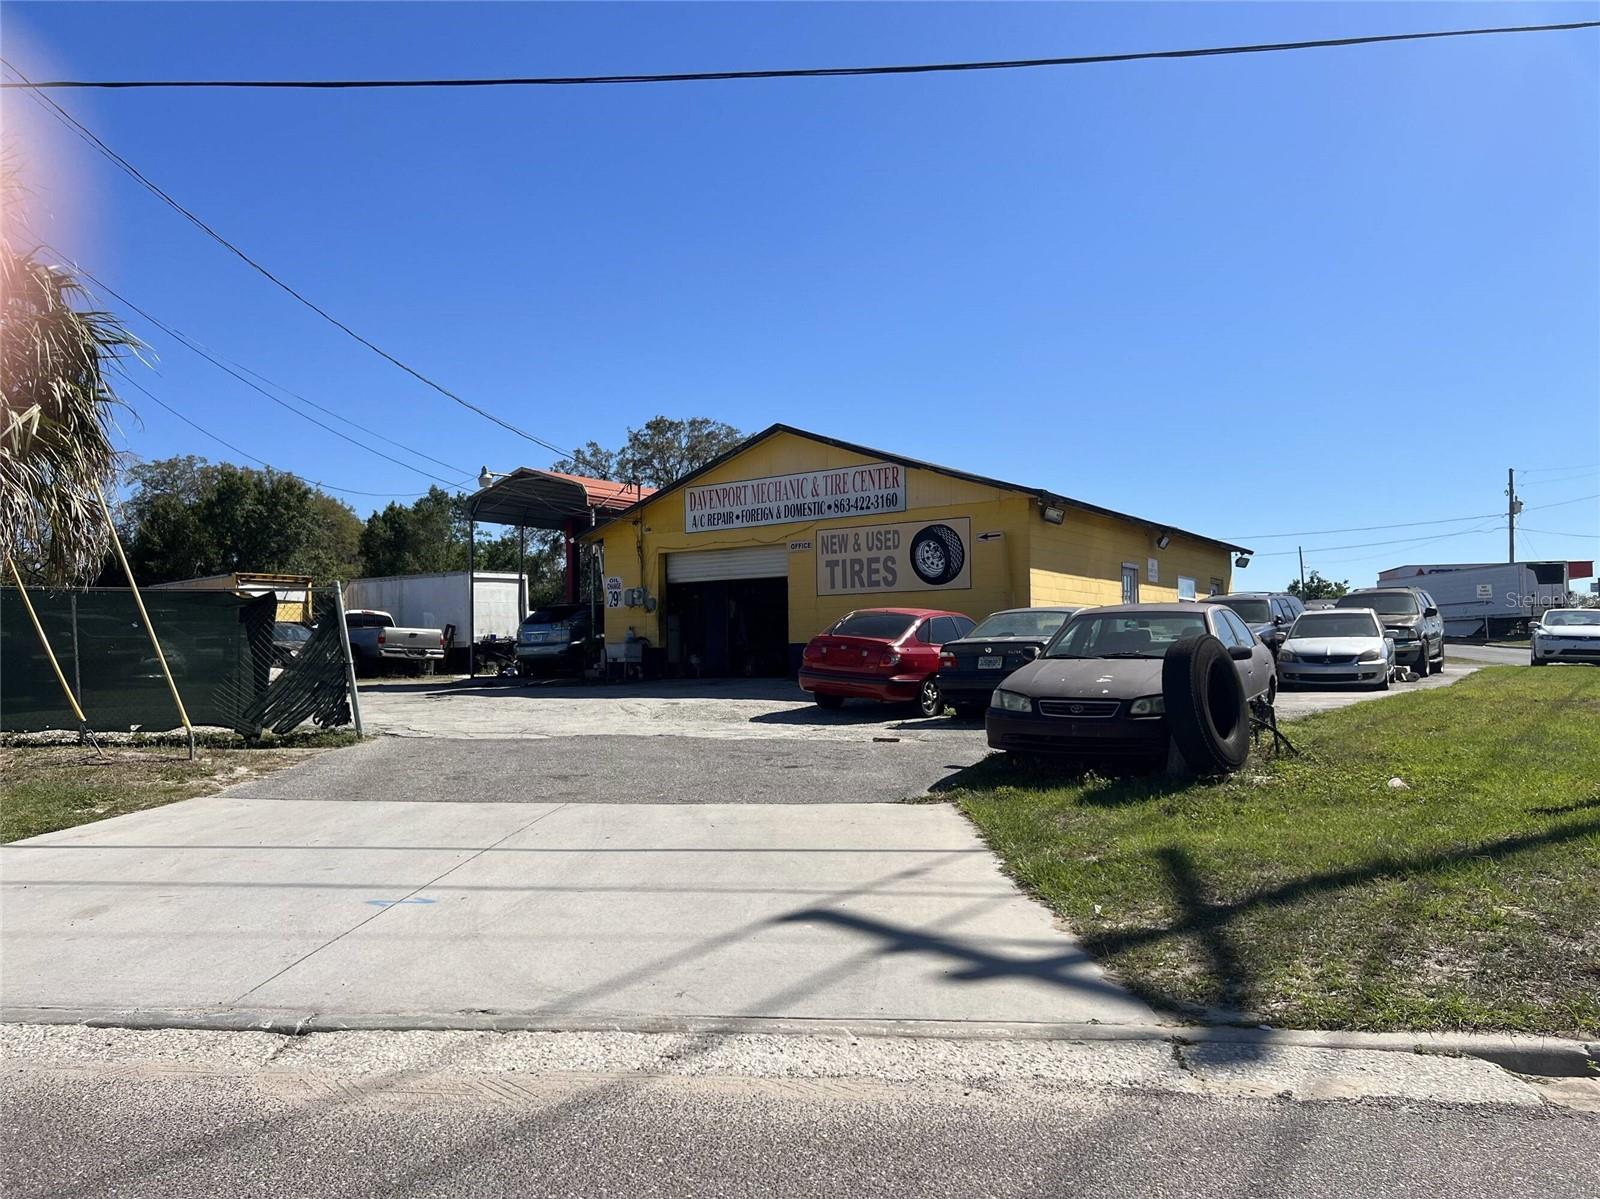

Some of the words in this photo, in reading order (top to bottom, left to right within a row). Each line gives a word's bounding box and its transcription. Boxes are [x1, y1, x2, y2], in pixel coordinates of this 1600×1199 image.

[689, 485, 748, 512] DAVENPORT
[751, 477, 808, 505] MECHANIC
[811, 476, 820, 498] &
[822, 472, 849, 497] TIRE
[852, 466, 900, 493] CENTER
[692, 514, 706, 529] A/C
[707, 511, 735, 527] REPAIR
[741, 506, 774, 523] FOREIGN
[776, 505, 782, 519] &
[784, 500, 826, 518] DOMESTIC
[833, 492, 898, 514] 863-422-3160
[790, 542, 812, 550] OFFICE
[820, 533, 849, 555] NEW
[852, 532, 862, 552] &
[865, 529, 901, 551] USED
[825, 555, 898, 590] TIRES
